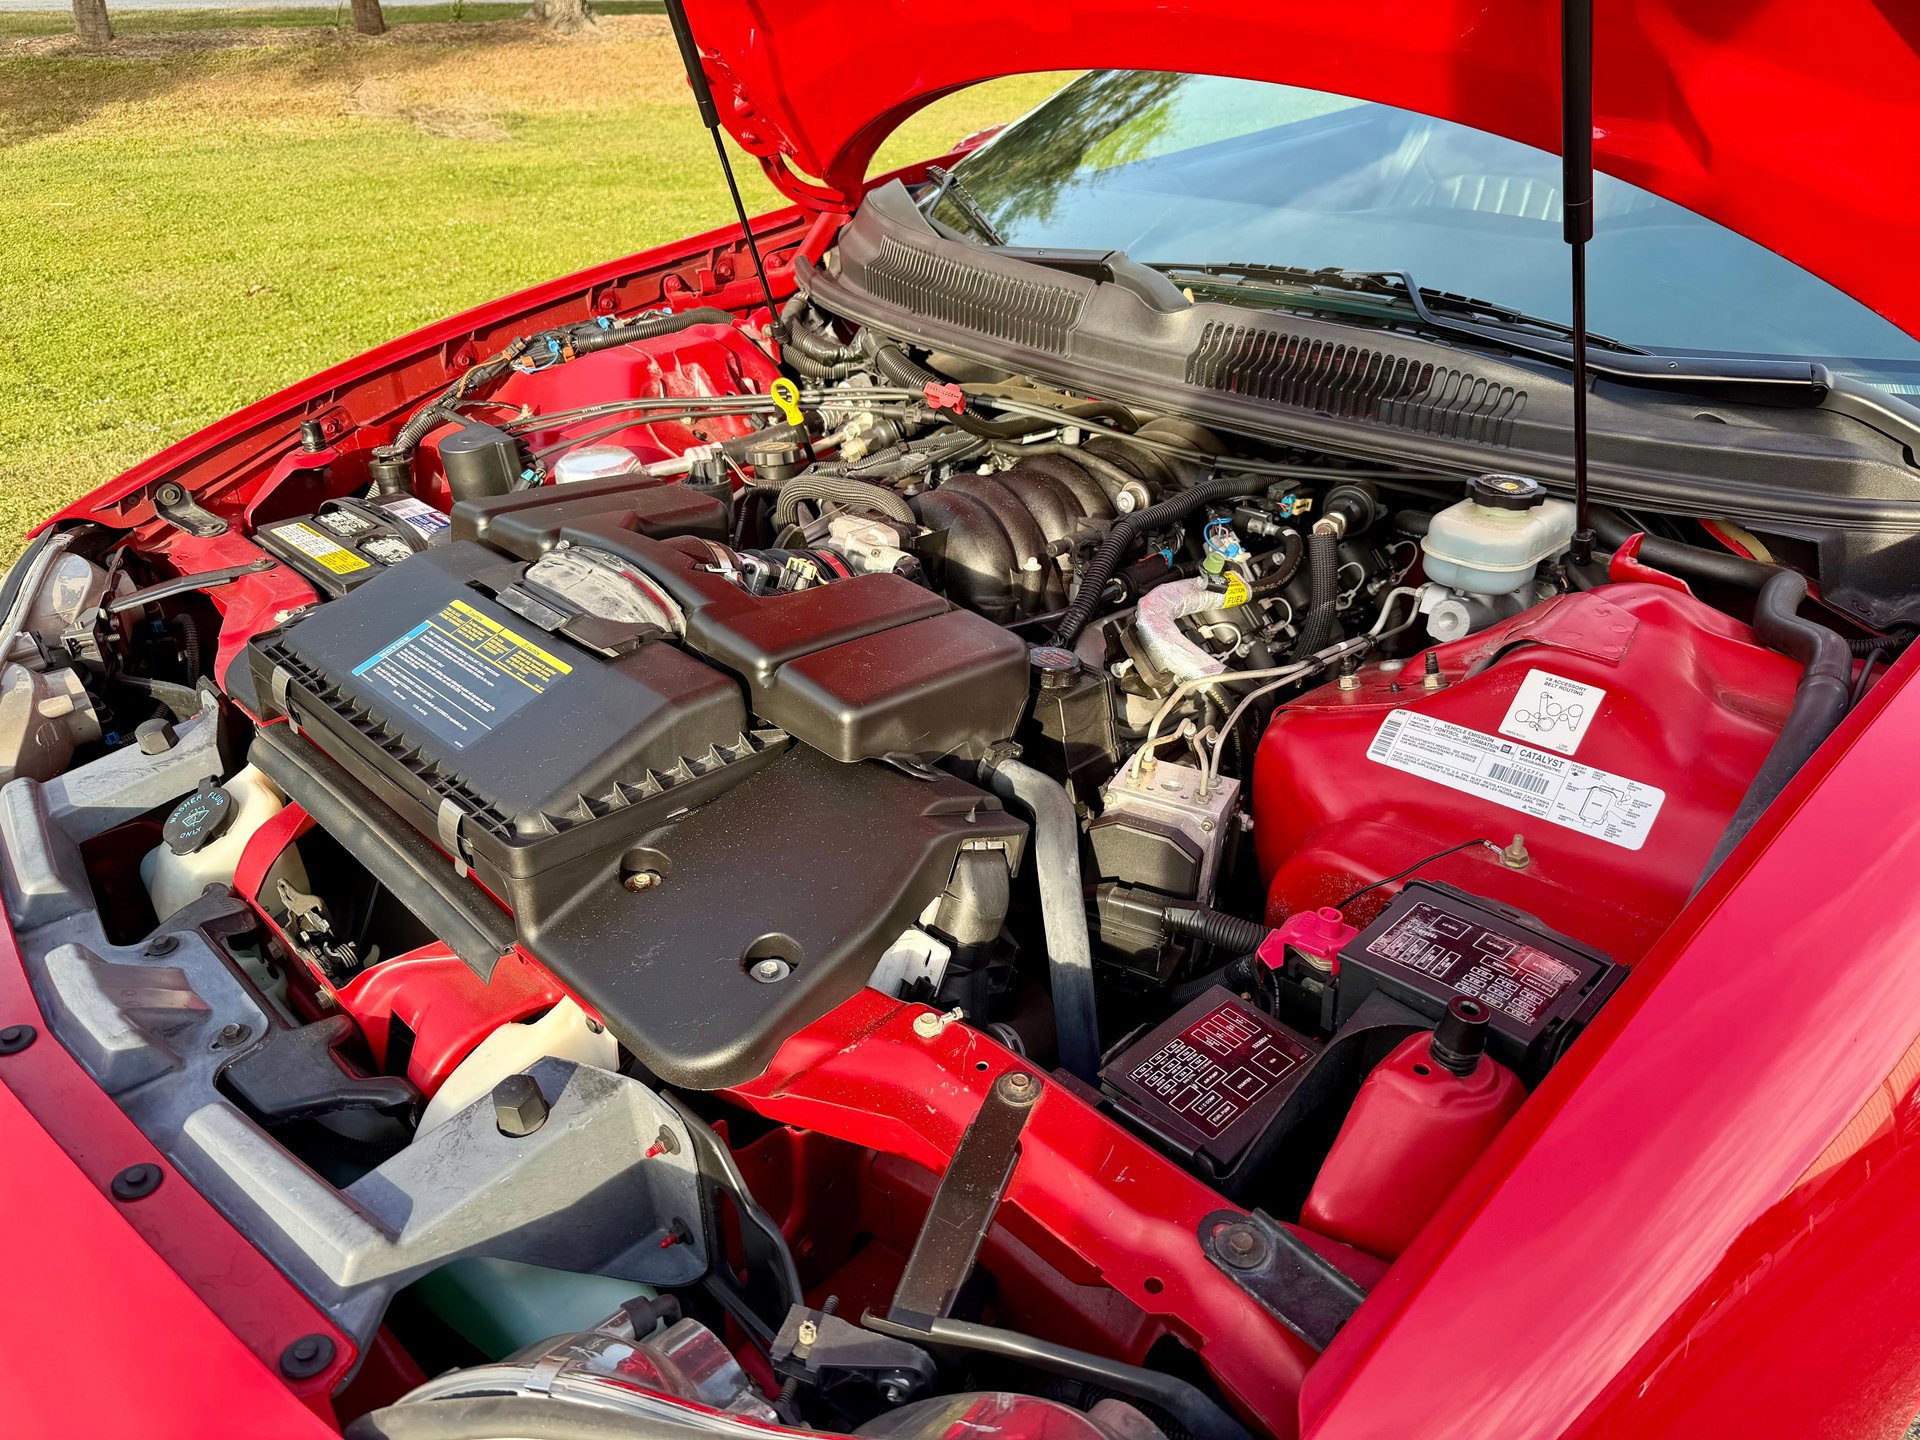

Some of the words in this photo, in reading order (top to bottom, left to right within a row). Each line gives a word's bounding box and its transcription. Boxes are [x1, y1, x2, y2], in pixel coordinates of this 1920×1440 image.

[1228, 596, 1243, 604] FUEL
[379, 635, 410, 659] NOTICE
[1543, 680, 1558, 688] BELT
[1557, 685, 1583, 696] ROUTING
[1552, 678, 1587, 692] ACCESSORY
[1432, 725, 1460, 737] CONTROL
[1461, 734, 1500, 750] INFORMATION
[1442, 723, 1467, 734] VEHICLE
[1466, 730, 1495, 743] EMISSION
[1408, 735, 1435, 746] ADJUSTMENTS
[1460, 751, 1477, 760] SERVICE
[1435, 731, 1452, 739] GENERAL
[1468, 742, 1496, 753] CORPORATION
[1518, 748, 1565, 769] CATALYST
[1571, 763, 1587, 771] FRONT
[1403, 753, 1420, 761] VEHICLE
[1420, 759, 1444, 769] CONFORMS
[1482, 779, 1512, 792] REGULATIONS
[1523, 793, 1550, 805] CALIFORNIA
[1497, 788, 1521, 799] PASSENGER
[169, 793, 204, 825] WASHER
[207, 791, 225, 806] FLUID
[179, 826, 202, 839] ONLY
[1491, 960, 1508, 970] HORN
[1524, 977, 1542, 987] LAMP
[1539, 984, 1553, 993] FOG
[1207, 1070, 1220, 1079] PUMP
[1236, 1076, 1253, 1089] STARTER
[1204, 1094, 1217, 1104] COMP
[1211, 1112, 1223, 1122] FUEL
[1219, 1105, 1232, 1115] PUMP
